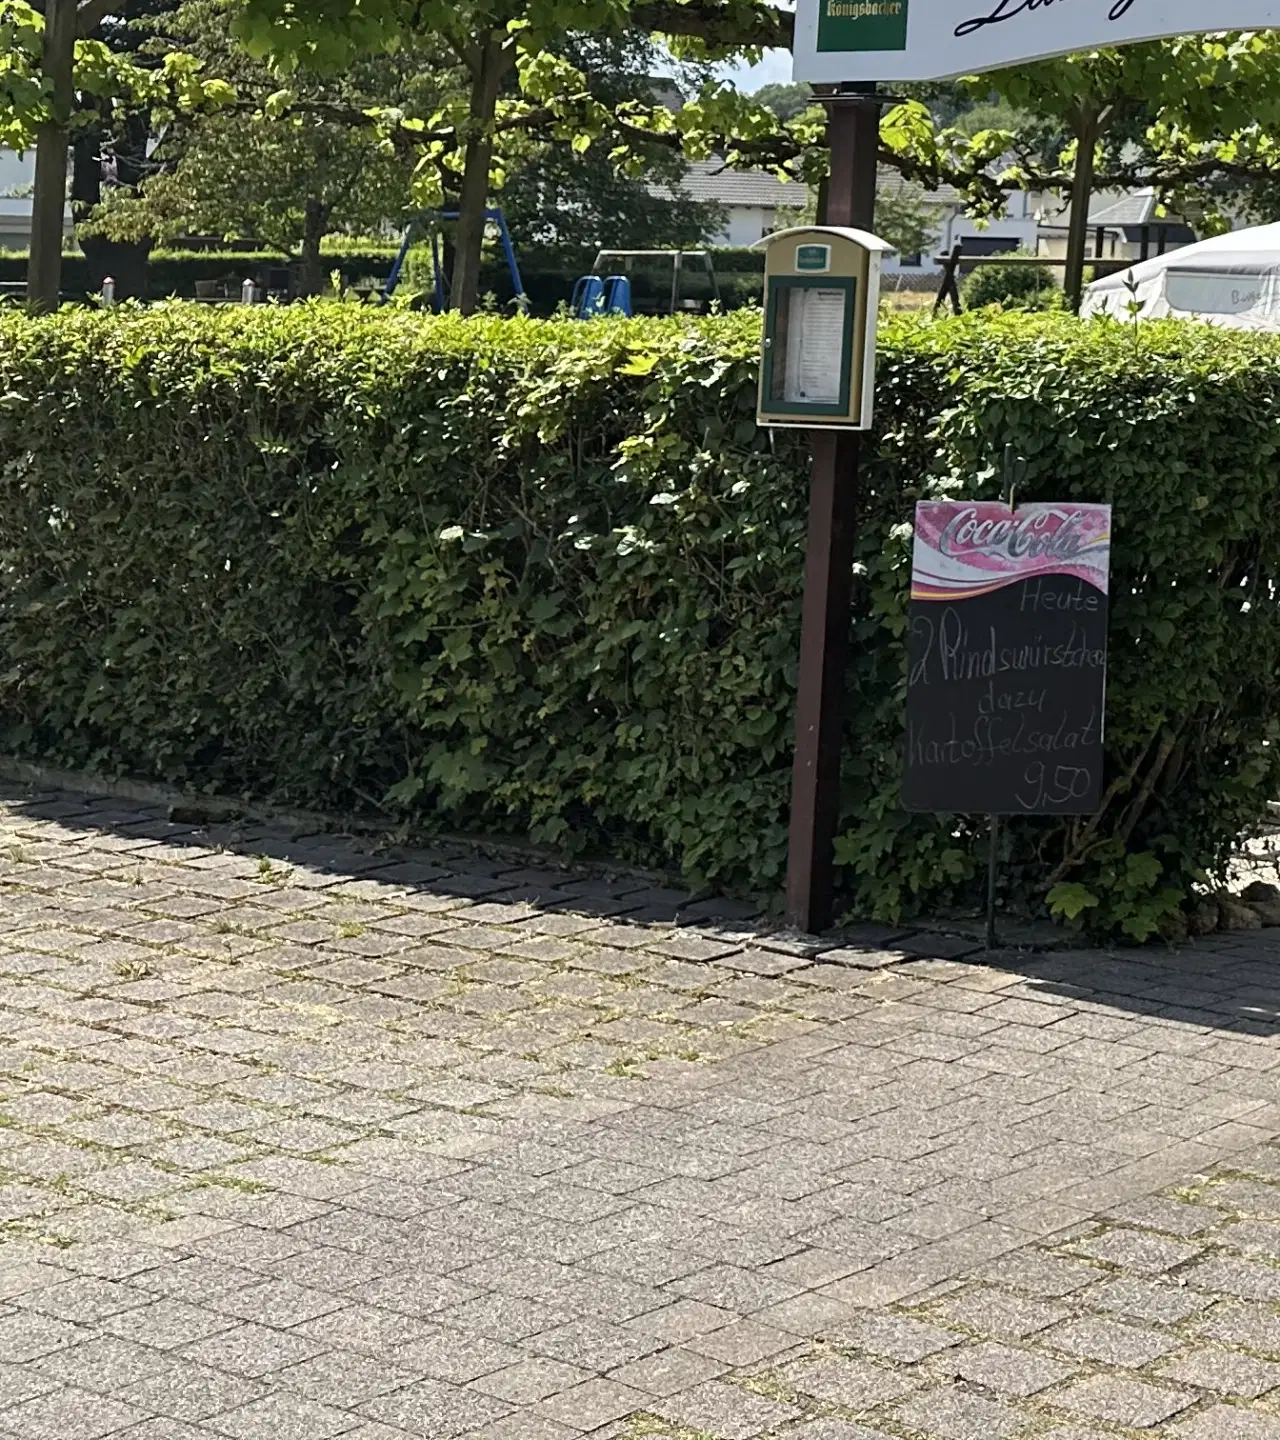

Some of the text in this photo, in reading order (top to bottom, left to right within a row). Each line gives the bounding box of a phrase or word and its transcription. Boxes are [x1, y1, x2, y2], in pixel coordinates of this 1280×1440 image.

[940, 508, 1083, 559] Coca-Cola
[1020, 578, 1098, 612] Heute
[979, 680, 1047, 713] dazu
